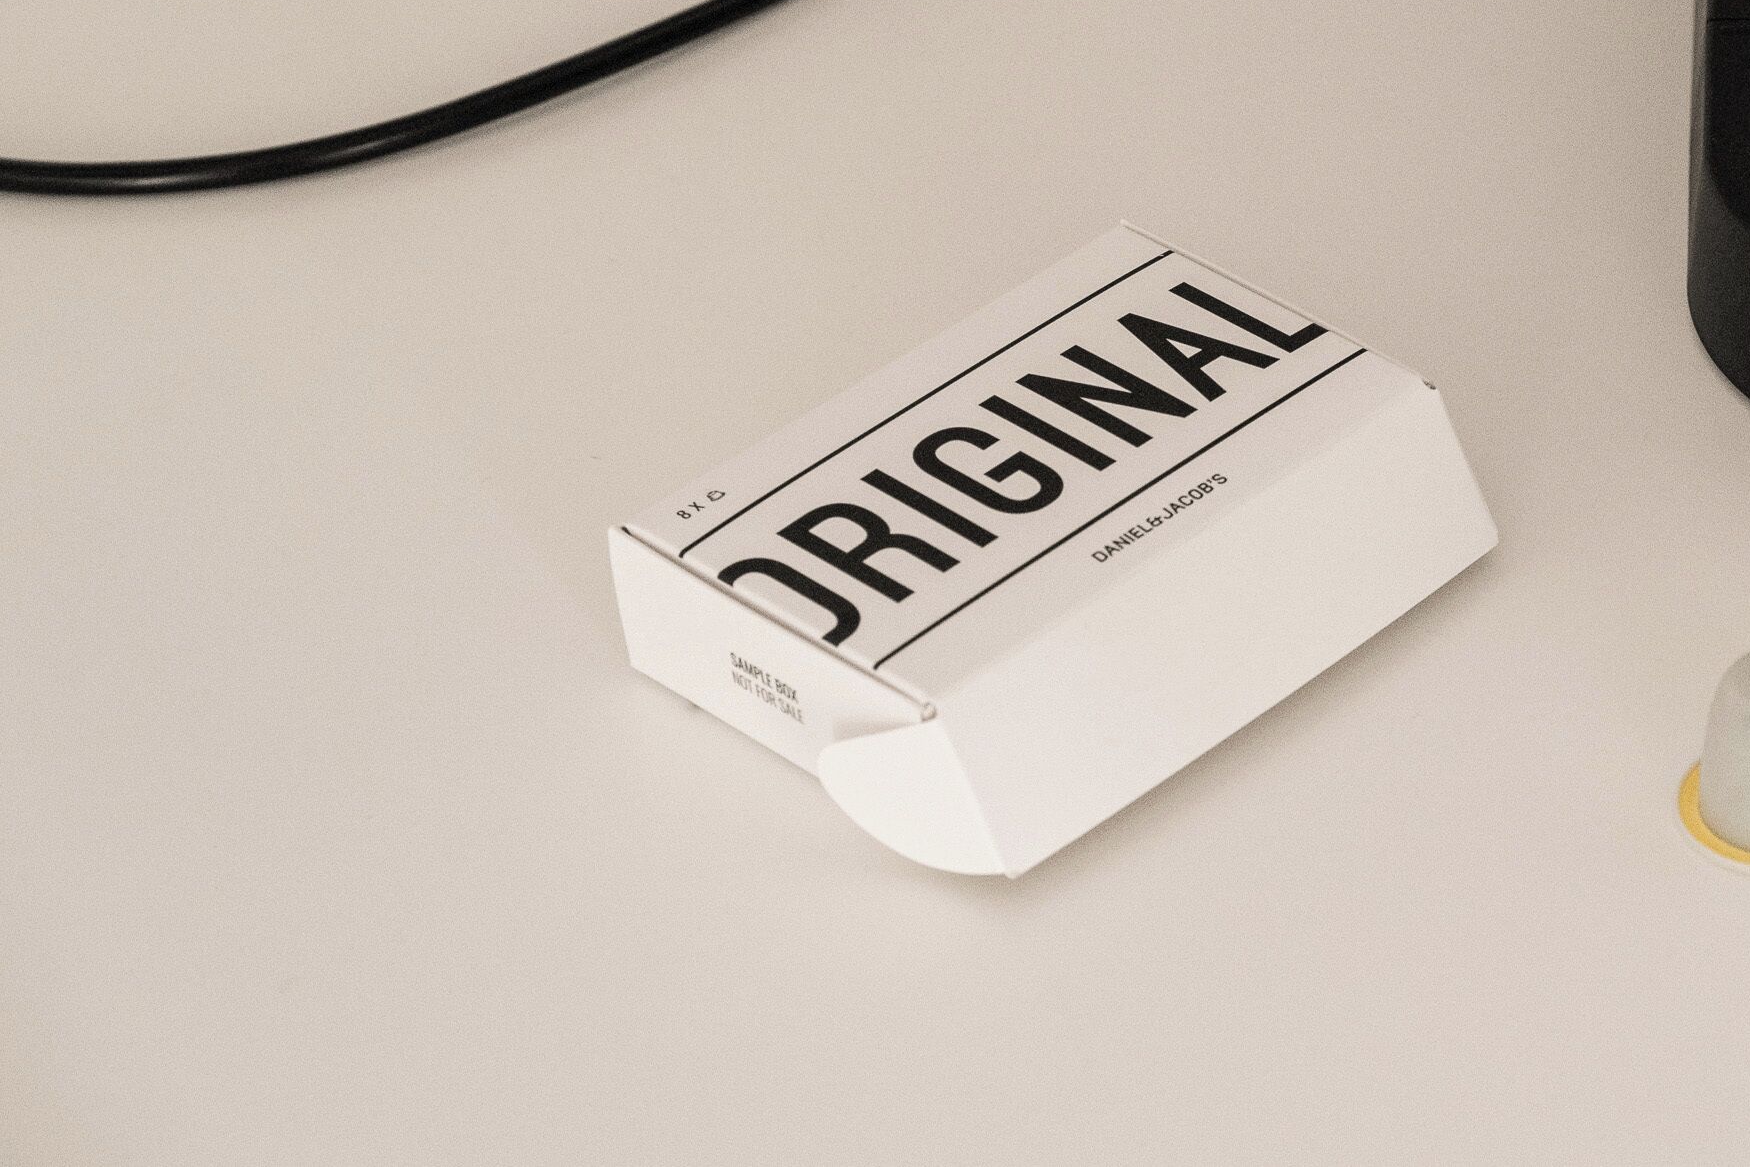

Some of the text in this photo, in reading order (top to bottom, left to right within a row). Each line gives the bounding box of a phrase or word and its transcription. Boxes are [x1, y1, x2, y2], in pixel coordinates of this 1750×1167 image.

[730, 652, 799, 705] SAMPLE BOX
[732, 670, 804, 725] NOT FOR SALE
